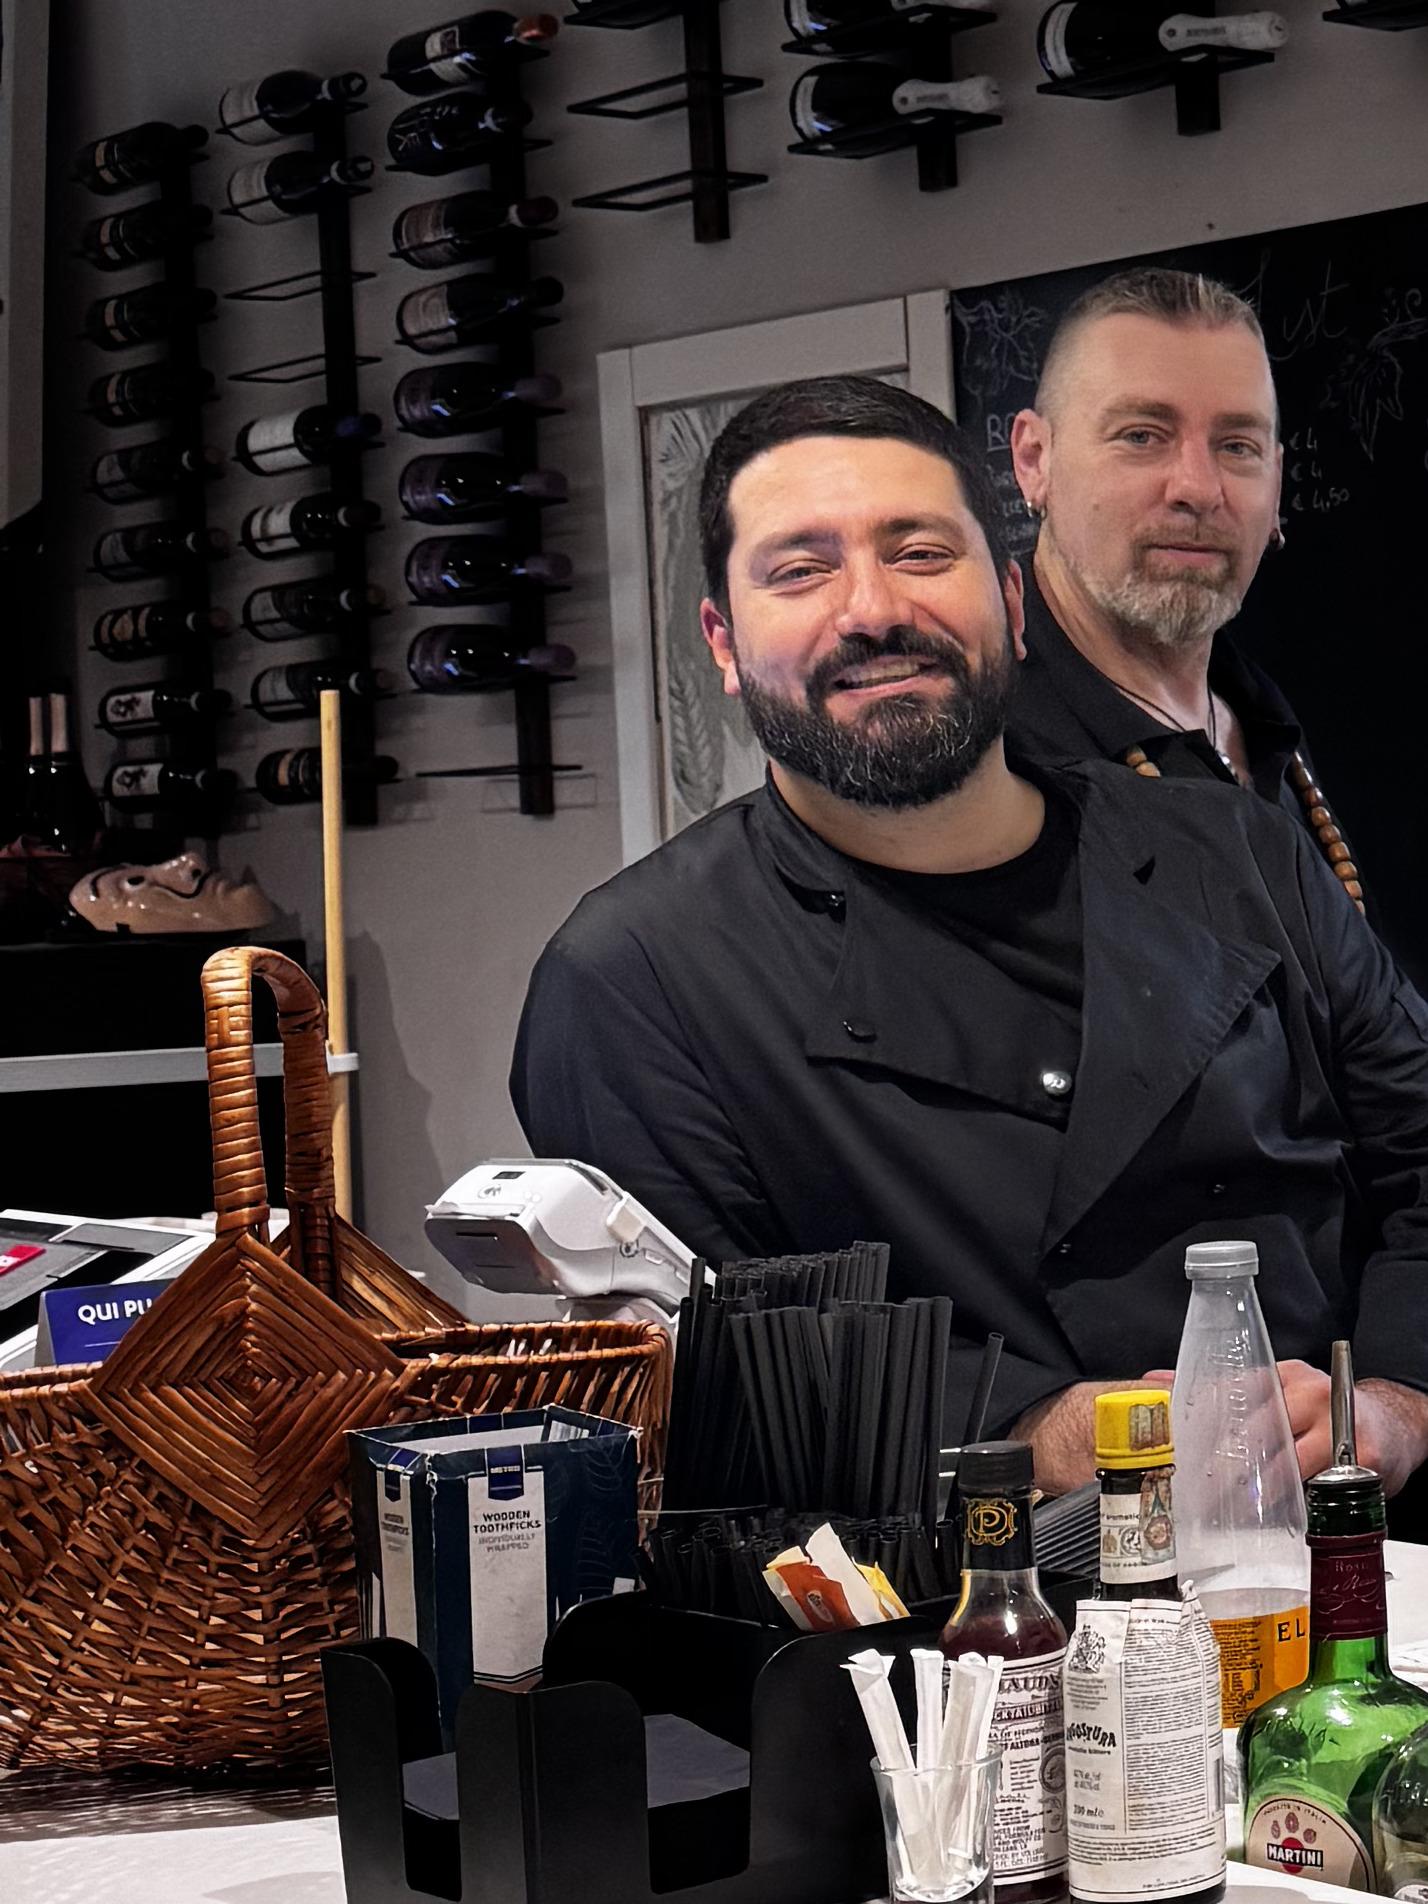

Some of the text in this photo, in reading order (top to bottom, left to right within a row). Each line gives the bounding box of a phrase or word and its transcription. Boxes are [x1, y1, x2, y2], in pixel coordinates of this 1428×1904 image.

[78, 1298, 152, 1325] QUI PU
[483, 1510, 531, 1522] WOODEN
[473, 1520, 541, 1534] TOOTHPICKS
[1268, 1845, 1322, 1866] MARTINI
